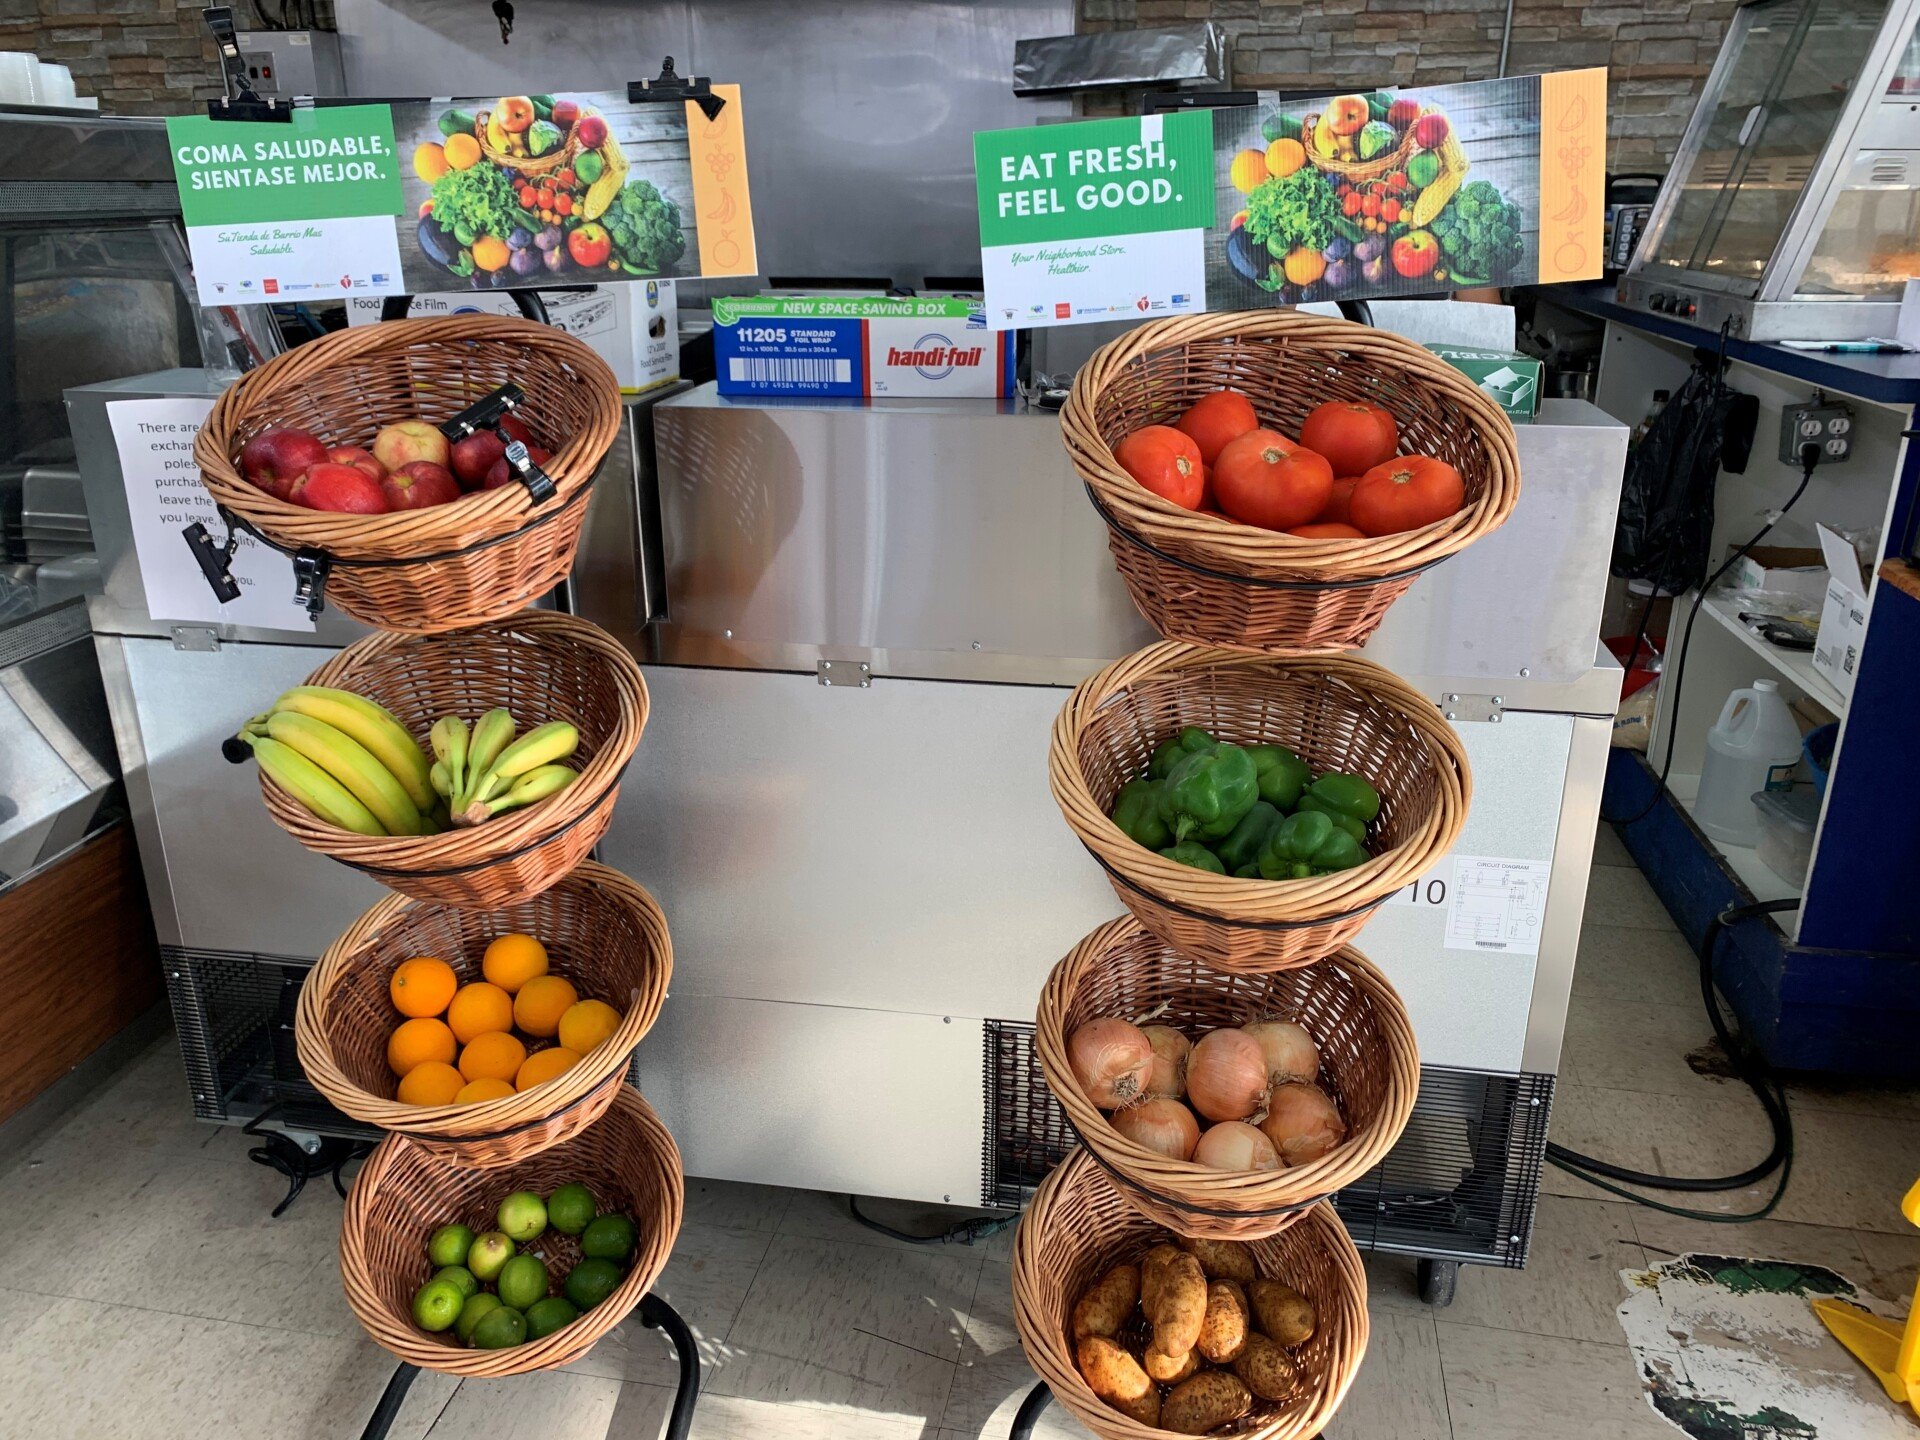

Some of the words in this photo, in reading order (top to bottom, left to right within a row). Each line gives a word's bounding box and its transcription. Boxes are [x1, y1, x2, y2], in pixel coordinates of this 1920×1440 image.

[178, 144, 247, 165] COMA
[254, 136, 391, 161] SALUDABLE,
[1001, 153, 1057, 182] EAT
[1068, 141, 1177, 176] FRESH,
[191, 166, 296, 189] SIENTASE
[304, 161, 386, 183] MEJOR.
[998, 188, 1065, 217] FEEL
[1076, 178, 1183, 211] GOOD.
[231, 231, 259, 242] Tienda
[260, 230, 270, 240] de
[272, 229, 301, 239] Barrio
[302, 227, 323, 239] Mas
[1011, 252, 1034, 267] Your
[1036, 244, 1098, 263] Neighborhood
[353, 298, 380, 309] Food
[424, 299, 448, 310] Film
[783, 302, 815, 314] NEW
[818, 303, 913, 315] SPACE-SAVING
[917, 303, 946, 315] BOX
[737, 328, 787, 343] 11205
[790, 329, 836, 338] STANDARD
[138, 423, 176, 433] There
[180, 424, 200, 433] are
[151, 441, 195, 451] exchan
[155, 477, 207, 488] purchas
[159, 495, 191, 505] leave
[194, 496, 213, 506] the
[160, 514, 182, 524] you
[1476, 861, 1500, 869] CIRCUIT
